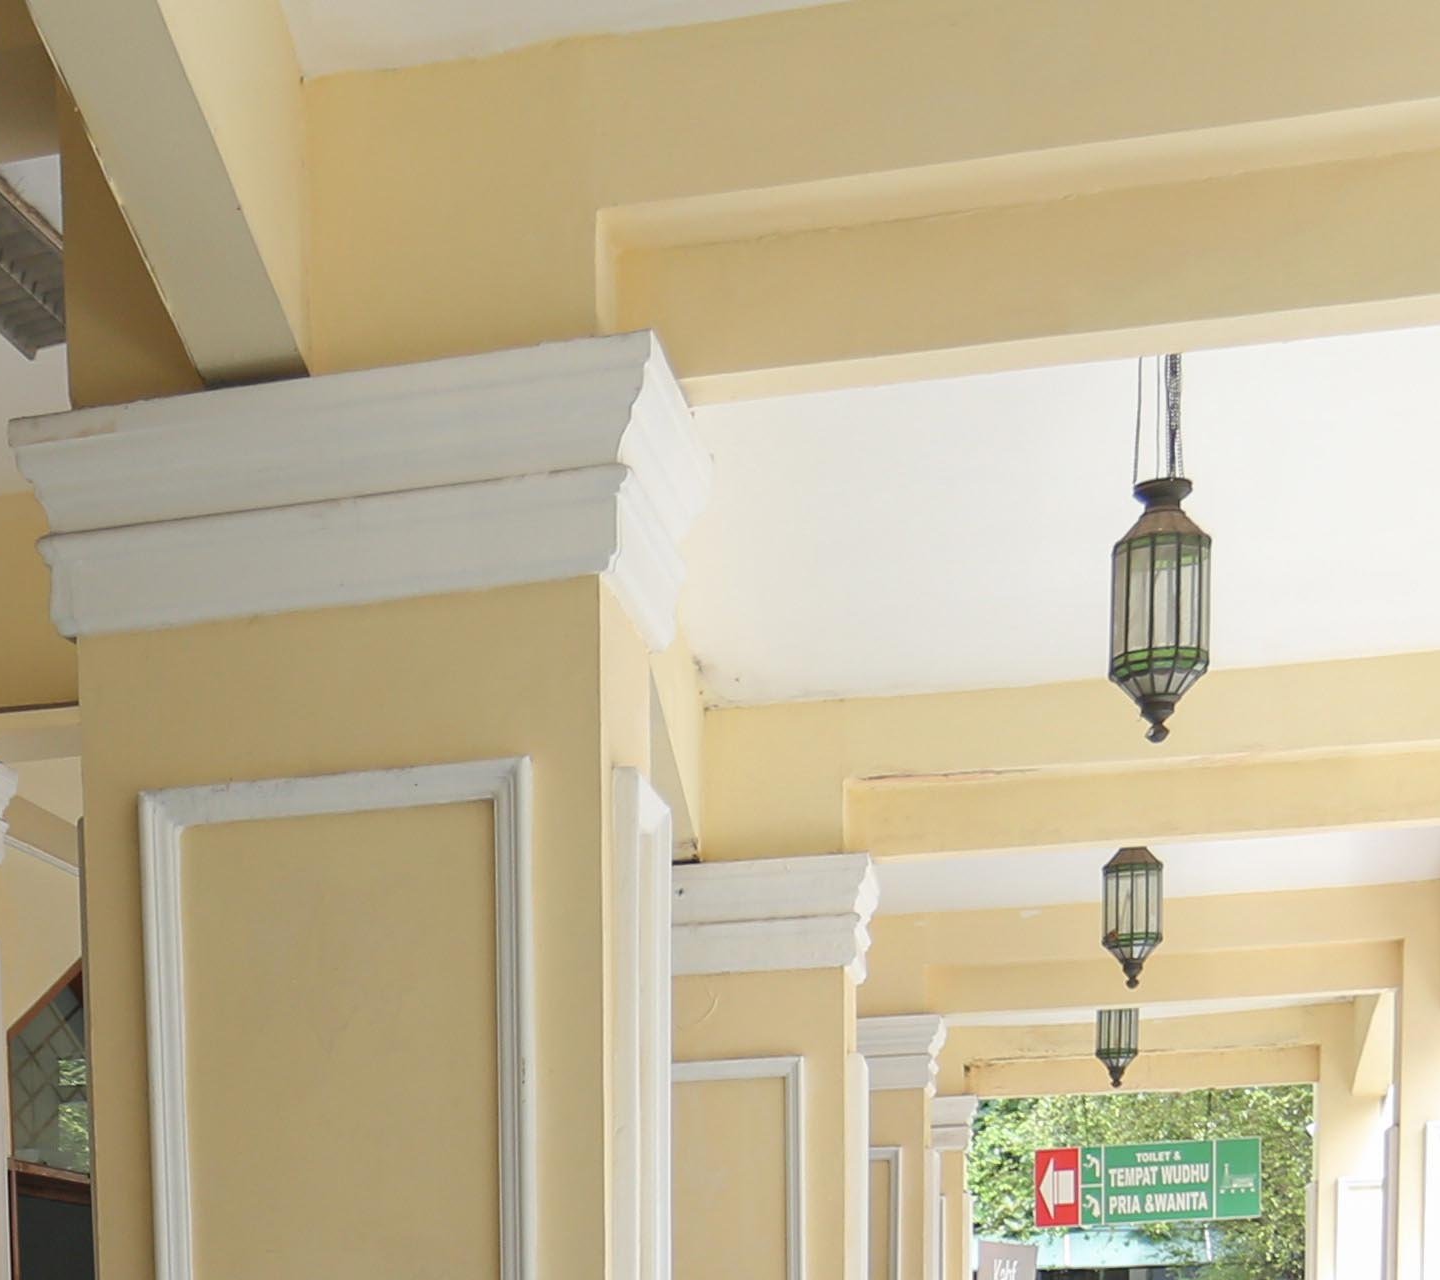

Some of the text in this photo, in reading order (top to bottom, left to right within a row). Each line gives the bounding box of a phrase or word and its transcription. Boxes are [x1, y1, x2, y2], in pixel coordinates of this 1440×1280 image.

[1135, 1151, 1182, 1163] TOILET &
[1108, 1163, 1209, 1187] TEMPAT WUDHU
[1108, 1195, 1141, 1215] PRIA
